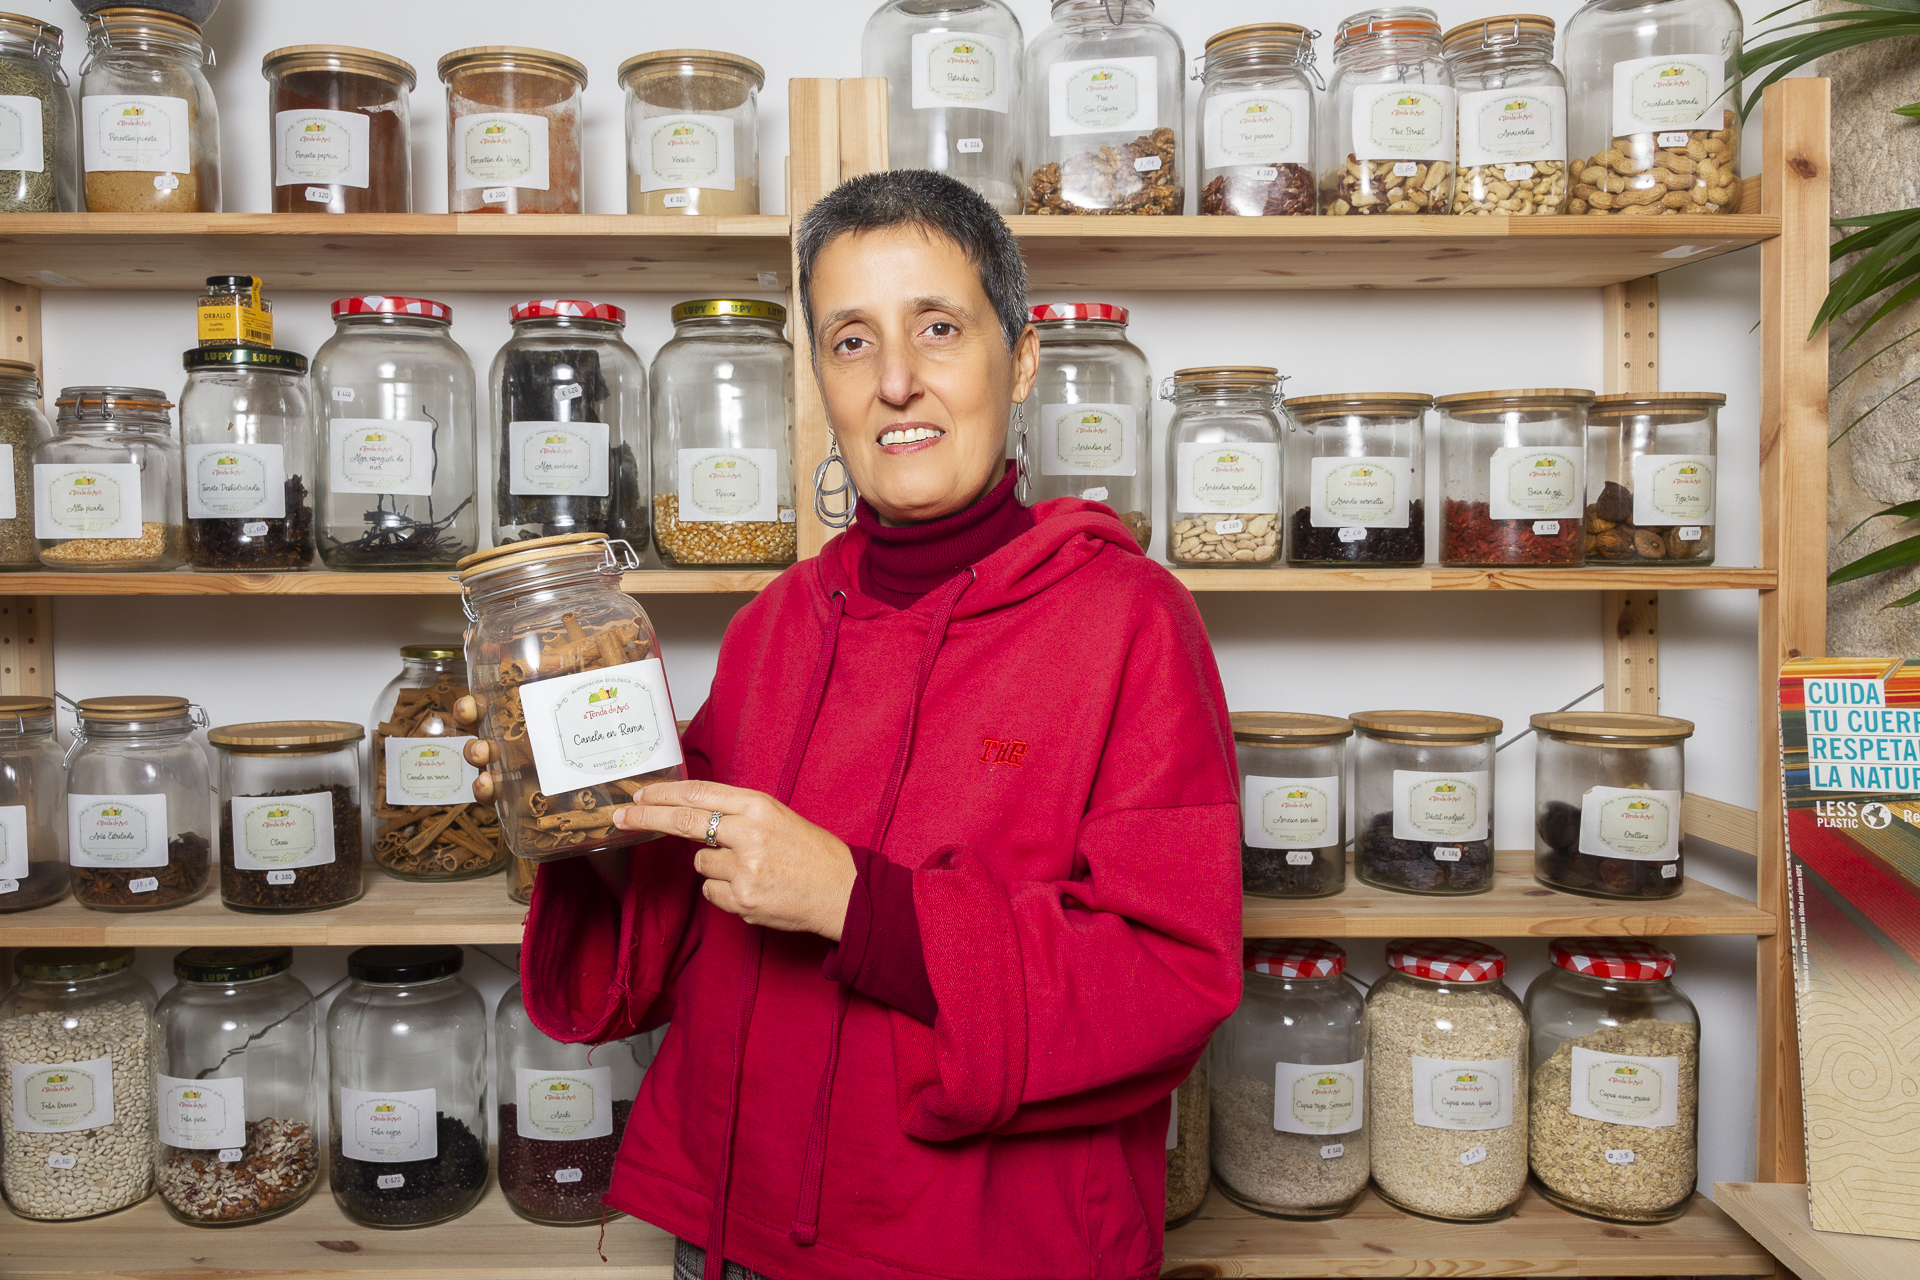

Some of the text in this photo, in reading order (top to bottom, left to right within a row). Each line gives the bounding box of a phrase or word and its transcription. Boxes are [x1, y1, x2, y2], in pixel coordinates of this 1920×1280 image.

[1642, 100, 1674, 108] Cacahuete
[1406, 127, 1425, 135] Brasil
[1498, 128, 1535, 138] Anacardos
[684, 306, 707, 314] LUPY
[252, 353, 281, 363] LUPY
[572, 679, 604, 694] ALIMENTACIÓN
[1808, 682, 1880, 704] CUIDA
[586, 709, 608, 719] Tenda
[617, 703, 629, 714] Avó
[1809, 710, 1837, 731] TU
[573, 731, 605, 746] Canela
[618, 723, 644, 736] Rama
[1812, 738, 1920, 761] RESPETA
[1815, 766, 1842, 788] LA
[1816, 801, 1857, 817] LESS
[1817, 818, 1858, 828] PLASTIC
[203, 973, 229, 981] LUPY
